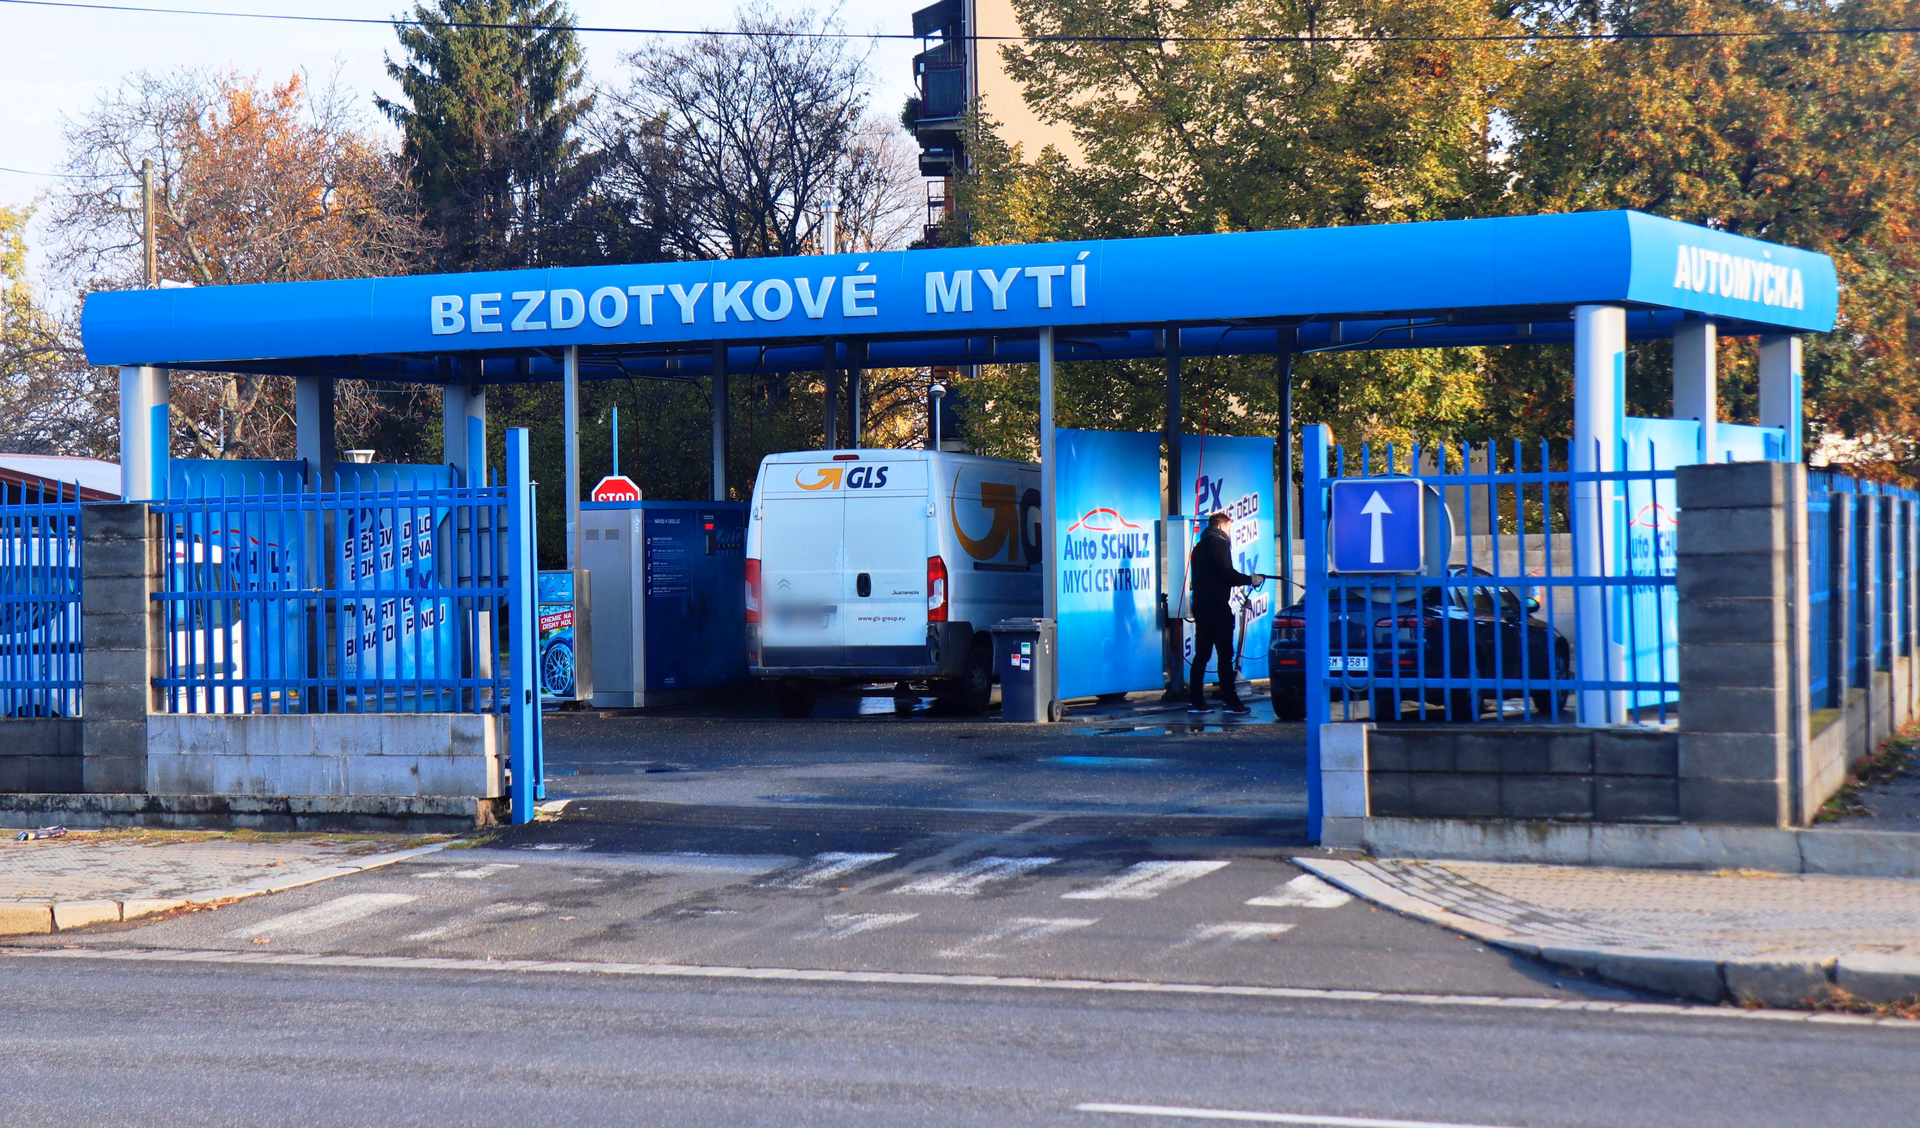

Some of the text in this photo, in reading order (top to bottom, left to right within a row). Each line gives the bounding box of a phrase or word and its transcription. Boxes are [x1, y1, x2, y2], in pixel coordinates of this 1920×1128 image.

[1673, 244, 1804, 310] AUTOMYČKA
[430, 251, 1091, 335] BEZDOTYKOVÉ MYTÍ
[846, 466, 889, 489] GLS
[1063, 533, 1150, 560] Auto SCHULZ
[1063, 564, 1150, 593] MYCÍ CENTRUM
